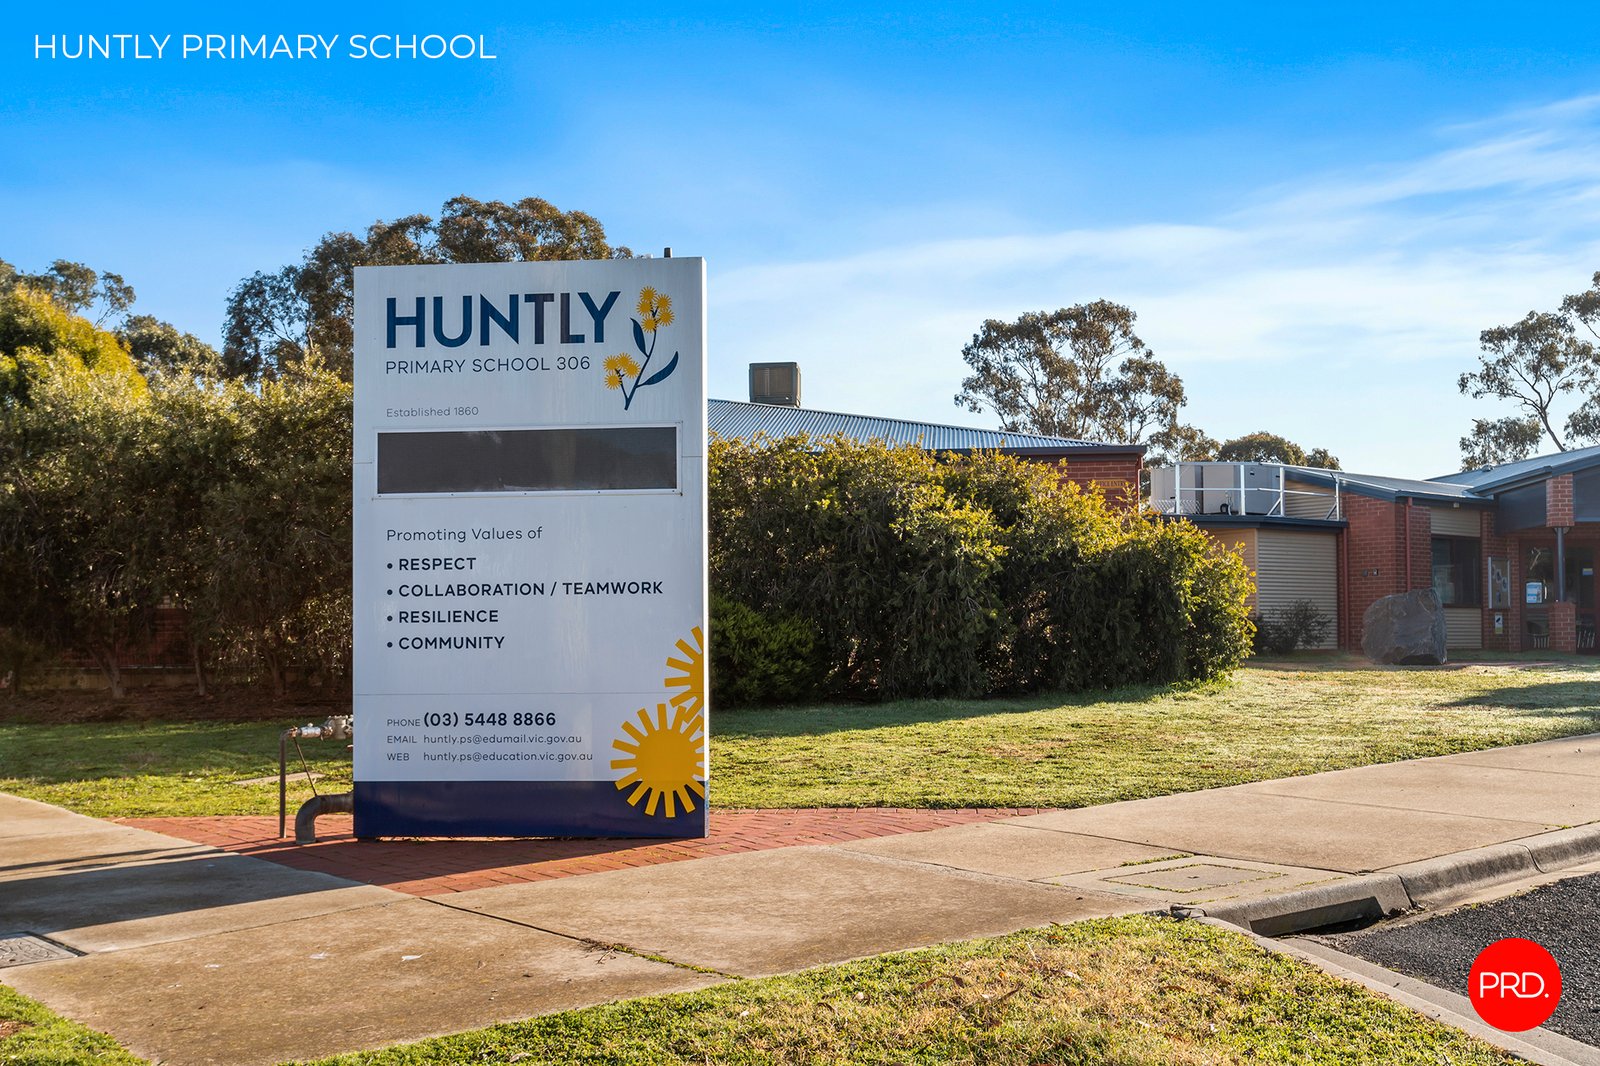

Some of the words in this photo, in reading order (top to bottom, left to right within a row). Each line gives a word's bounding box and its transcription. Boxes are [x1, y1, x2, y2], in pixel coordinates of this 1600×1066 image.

[387, 291, 621, 348] HUNTLY
[385, 359, 466, 375] PRIMARY
[472, 357, 551, 373] SCHOOL
[556, 355, 591, 371] 306
[386, 406, 451, 418] Established
[453, 406, 479, 416] 1860
[386, 528, 467, 544] Promoting
[471, 527, 523, 540] Values
[527, 525, 543, 540] of
[398, 557, 477, 571] RESPECT
[398, 582, 545, 598] COLLABORATION
[550, 581, 558, 597] /
[562, 580, 664, 595] TEAMWORK
[398, 609, 499, 624] RESILIENCE
[398, 636, 505, 650] COMMUNITY
[386, 718, 421, 727] PHONE
[423, 711, 459, 728] (03)
[464, 712, 508, 727] 5448
[512, 712, 556, 727] 8866
[386, 735, 418, 744] EMAIL
[423, 733, 582, 746] huntly.ps@edumail.vic.gov.au
[386, 752, 410, 762] WEB
[423, 751, 593, 763] huntly.ps@education.vic.gov.au
